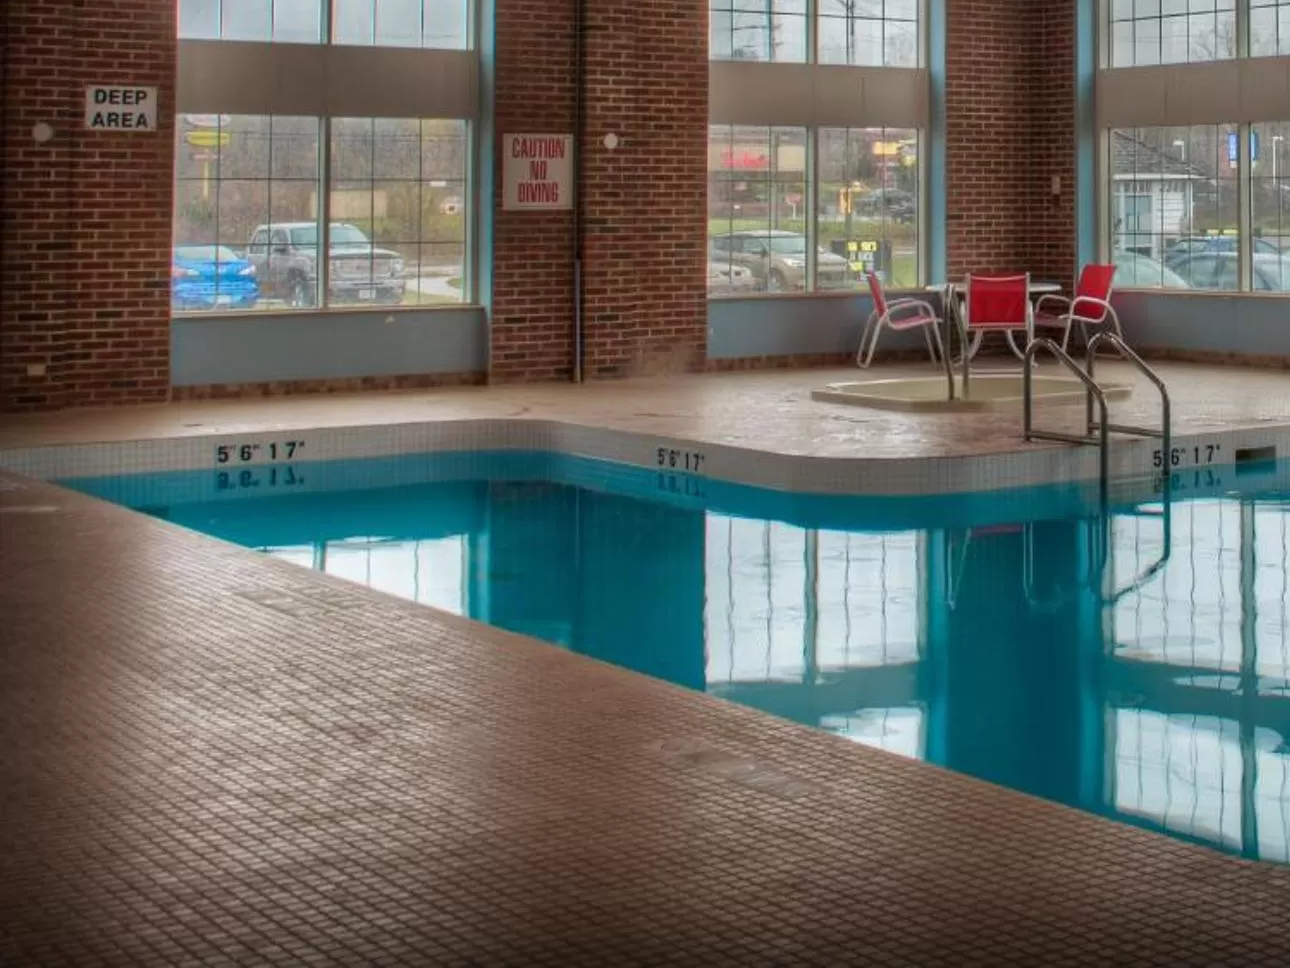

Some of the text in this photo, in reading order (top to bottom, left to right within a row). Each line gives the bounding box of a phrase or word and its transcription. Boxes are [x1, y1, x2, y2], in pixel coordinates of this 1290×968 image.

[94, 88, 147, 105] DEEP
[92, 112, 148, 128] AREA
[512, 138, 565, 159] CAUTION
[530, 160, 547, 180] NO
[518, 182, 558, 203] DIVING
